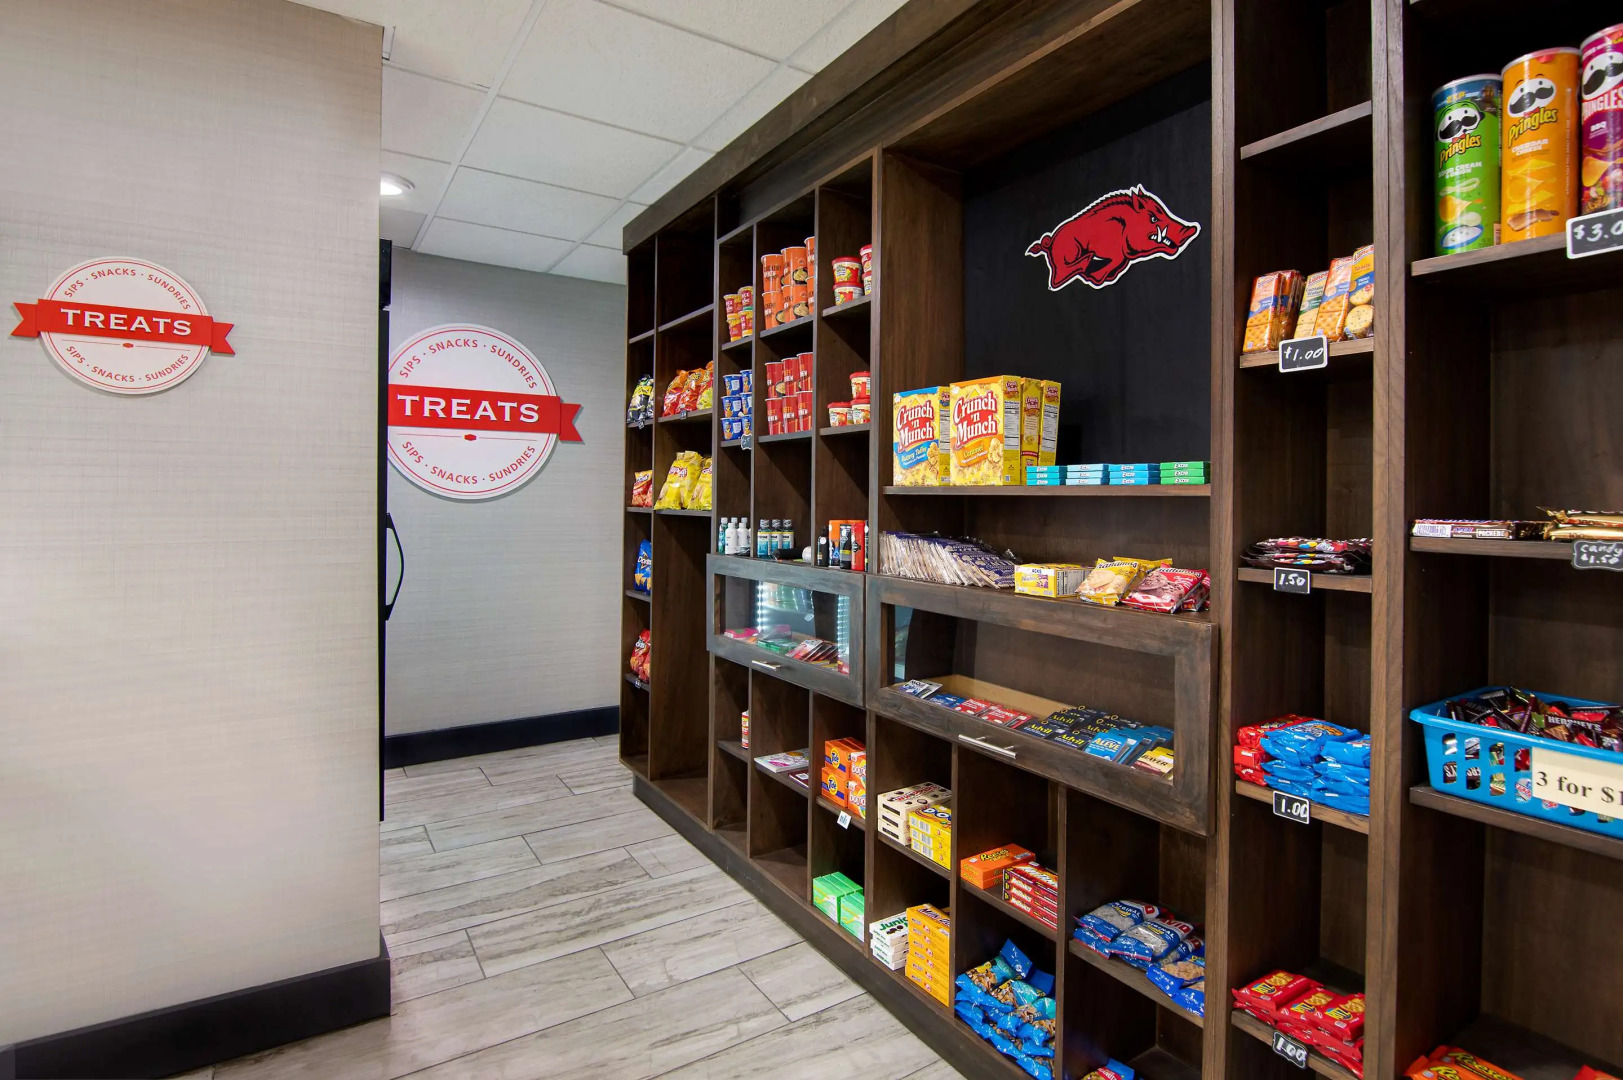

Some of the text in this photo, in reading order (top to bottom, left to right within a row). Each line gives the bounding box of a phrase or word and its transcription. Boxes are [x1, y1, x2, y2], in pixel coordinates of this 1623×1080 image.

[1508, 107, 1557, 149] Pringles
[1440, 134, 1482, 171] Pringles
[64, 267, 191, 311] SIPS SNACKS SUNDRIES
[60, 307, 192, 336] TREATS
[66, 345, 189, 383] SIPS SNACKS SUNDRIES
[399, 338, 538, 389] SIPS SNACKS SUNDRIES
[1284, 346, 1324, 361] $1.00
[397, 394, 540, 423] TREATS
[897, 400, 935, 431] Crunch
[953, 390, 997, 424] Crunch
[898, 423, 935, 452] Munch
[955, 414, 998, 450] Munch
[402, 441, 536, 484] SIPS SNACKS SUNDRIES
[1278, 573, 1306, 586] 1.50
[1030, 723, 1052, 734] Advil
[1060, 733, 1085, 745] Advil
[1093, 737, 1121, 751] ALEVE
[1536, 771, 1548, 787] 3
[1557, 776, 1593, 797] for
[1281, 798, 1308, 818] 1.00
